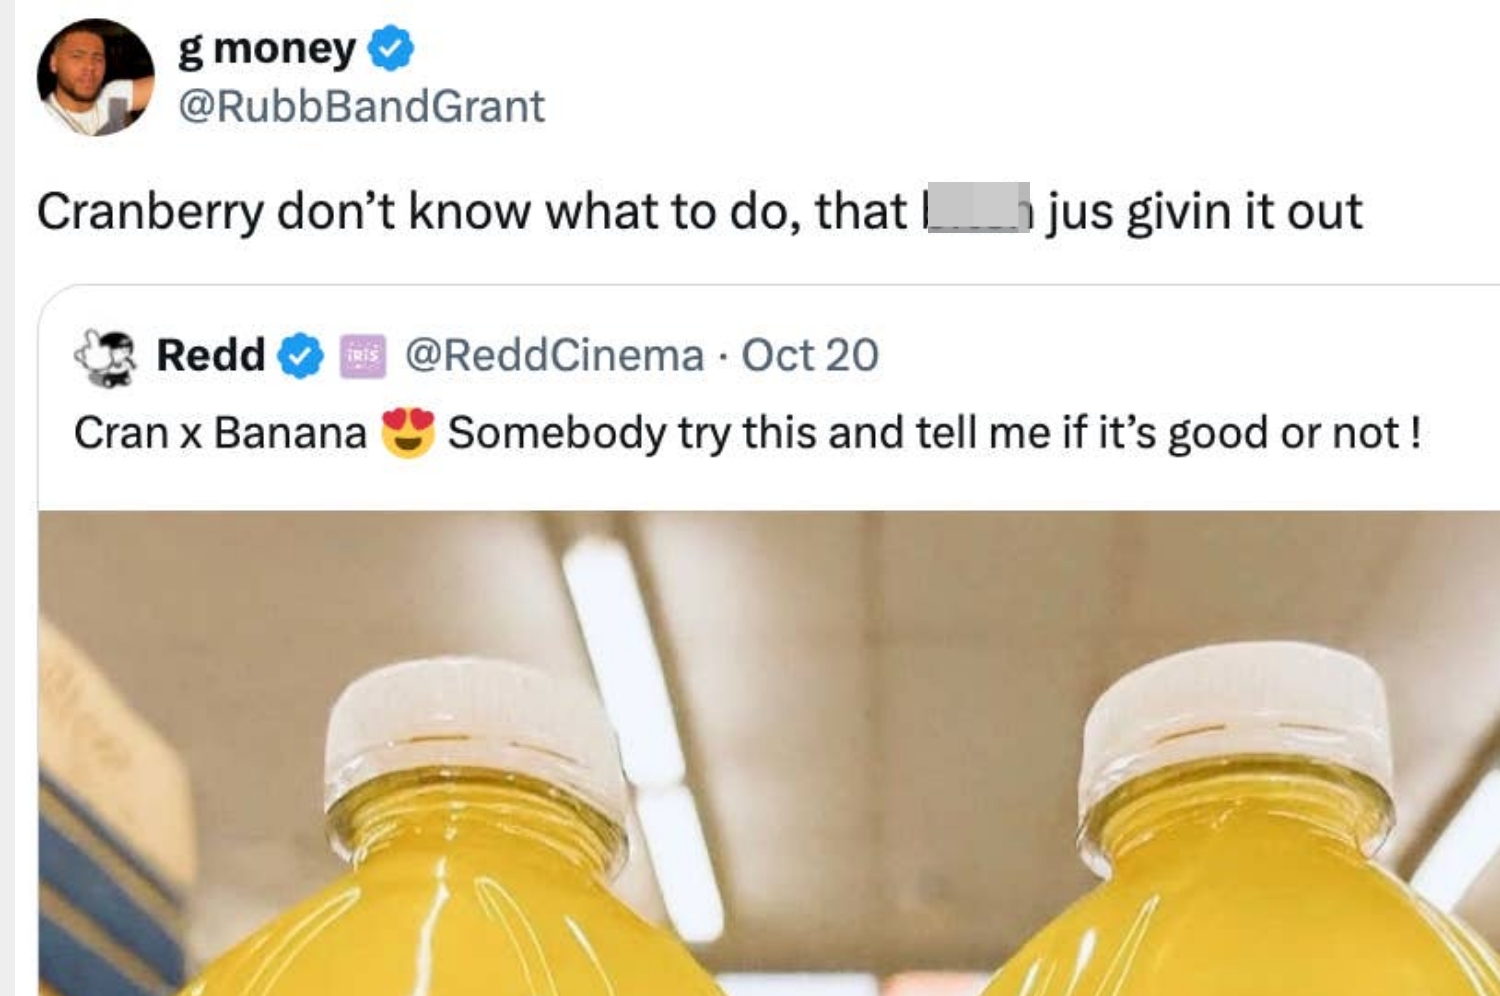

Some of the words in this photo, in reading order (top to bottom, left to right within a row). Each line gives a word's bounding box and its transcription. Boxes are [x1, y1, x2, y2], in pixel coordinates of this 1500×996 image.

[177, 33, 204, 73] g
[214, 37, 358, 73] money
[179, 87, 546, 124] @RubbBandGrant
[37, 188, 265, 241] Cranberry
[277, 188, 396, 230] don’t
[410, 188, 532, 230] know
[544, 188, 660, 230] what
[669, 192, 717, 230] to
[730, 188, 801, 237] do,
[813, 188, 908, 231] that
[1044, 189, 1114, 241] jus
[1126, 189, 1231, 241] givin
[1246, 189, 1276, 230] it
[1287, 192, 1364, 230] out
[157, 335, 265, 372] Redd
[406, 335, 704, 373] @ReddCinema
[742, 336, 816, 372] Oct
[826, 336, 879, 372] 20
[74, 414, 169, 450] Cran
[179, 423, 203, 449] x
[215, 414, 367, 450] Banana
[448, 412, 668, 458] Somebody
[677, 416, 733, 458] try
[741, 412, 817, 450] this
[828, 412, 904, 450] and
[915, 412, 976, 450] tell
[990, 422, 1052, 450] me
[1062, 412, 1089, 449] if
[1099, 413, 1157, 450] it’s
[1167, 412, 1268, 458] good
[1280, 422, 1323, 450] or
[1333, 416, 1400, 450] not
